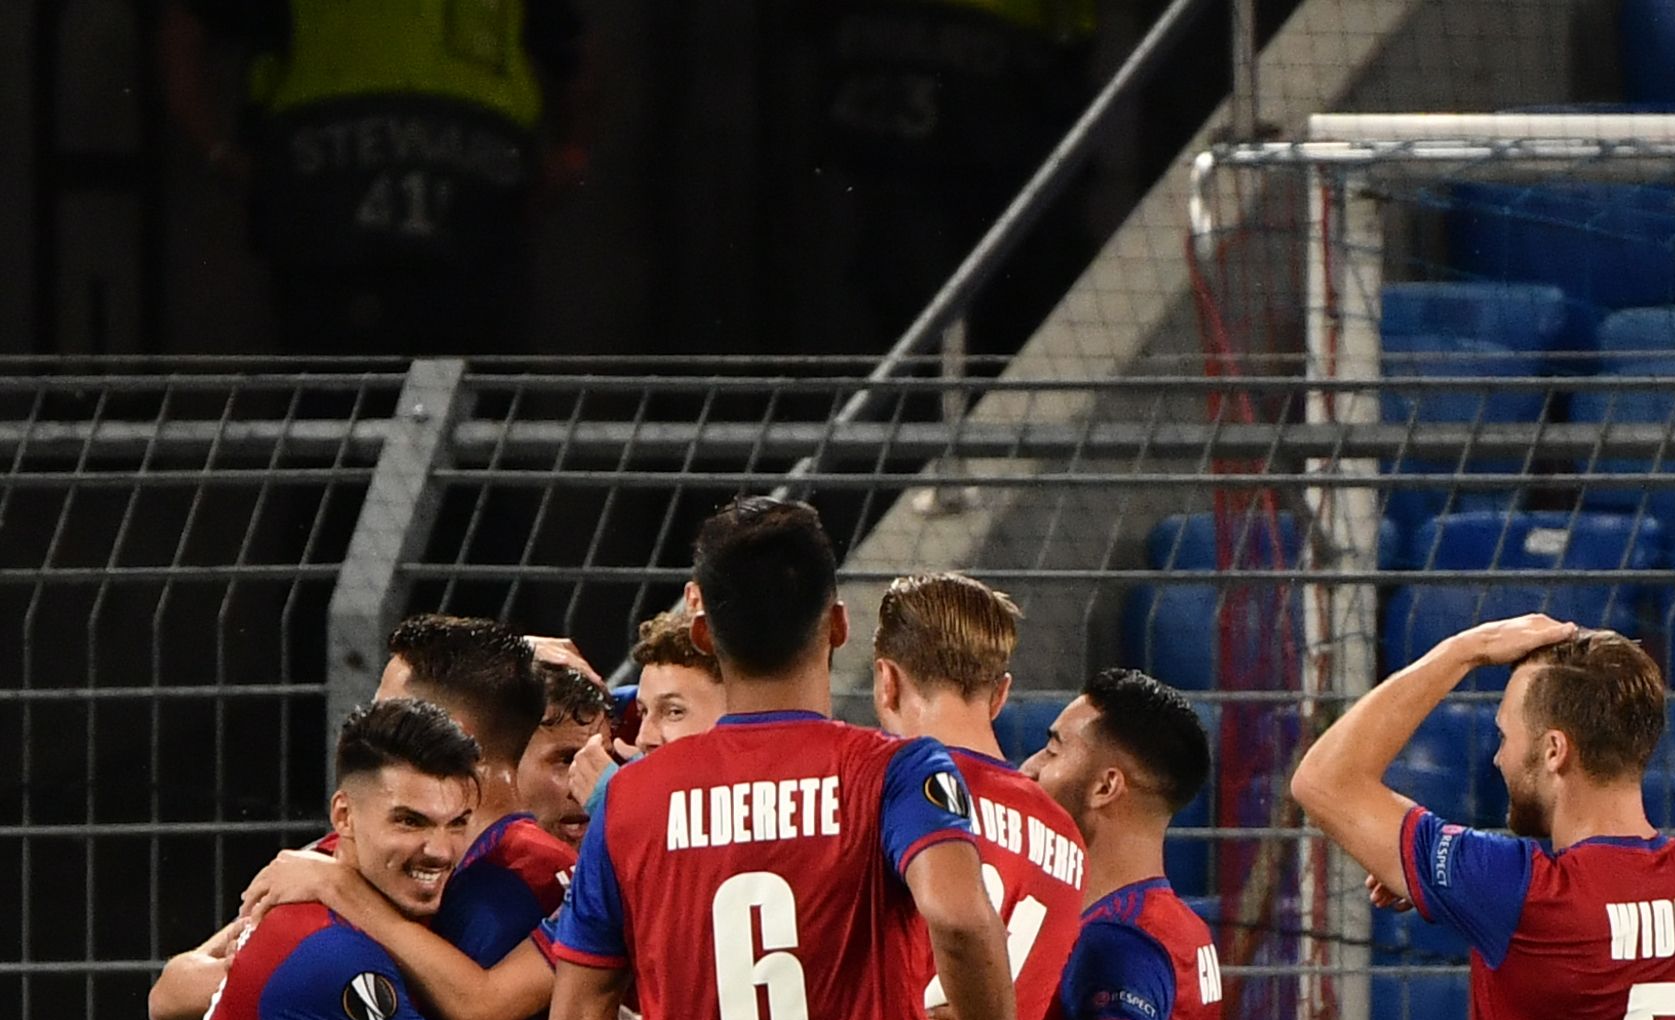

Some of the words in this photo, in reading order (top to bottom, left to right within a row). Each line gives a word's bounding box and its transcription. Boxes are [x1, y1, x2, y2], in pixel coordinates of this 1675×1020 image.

[667, 775, 840, 851] ALDERETE
[979, 797, 1022, 855] DER
[1028, 816, 1084, 891] WERFF
[1436, 834, 1453, 888] RESPECT
